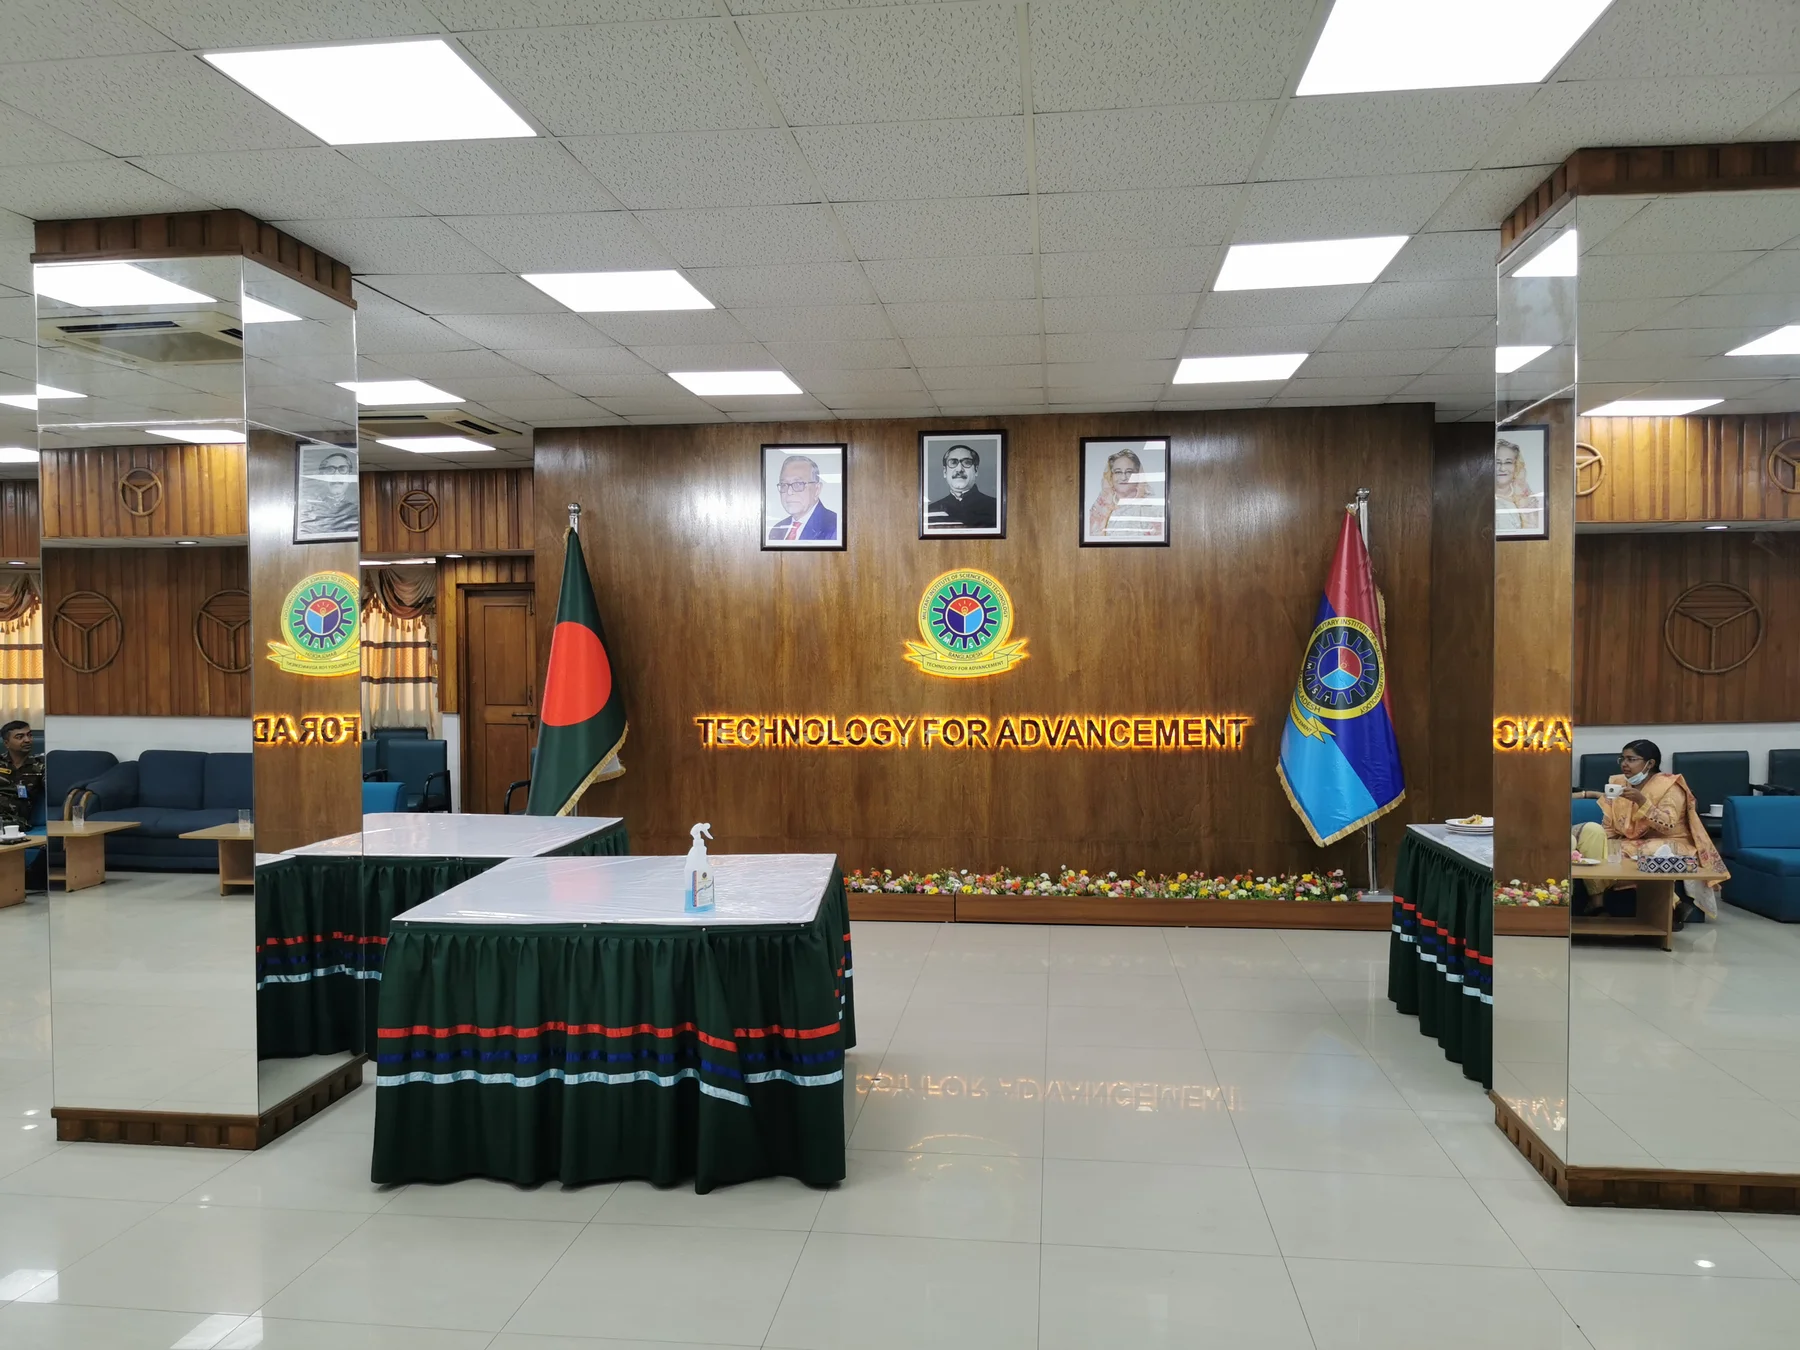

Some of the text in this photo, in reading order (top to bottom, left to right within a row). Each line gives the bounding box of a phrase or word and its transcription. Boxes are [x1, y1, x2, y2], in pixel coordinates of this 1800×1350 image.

[929, 575, 951, 598] INSTITUTE
[959, 573, 981, 581] SCIENCE
[991, 584, 1009, 619] TECHNOLOGY
[1314, 619, 1340, 636] MILITARY
[1340, 619, 1369, 636] INSTITUTE
[948, 651, 984, 660] BANGLADESH
[926, 661, 958, 671] TECHNOLOGY
[968, 660, 1004, 671] ADVANCEMENT
[697, 716, 1248, 748] TECHNOLOGY FOR ADVANCEMENT
